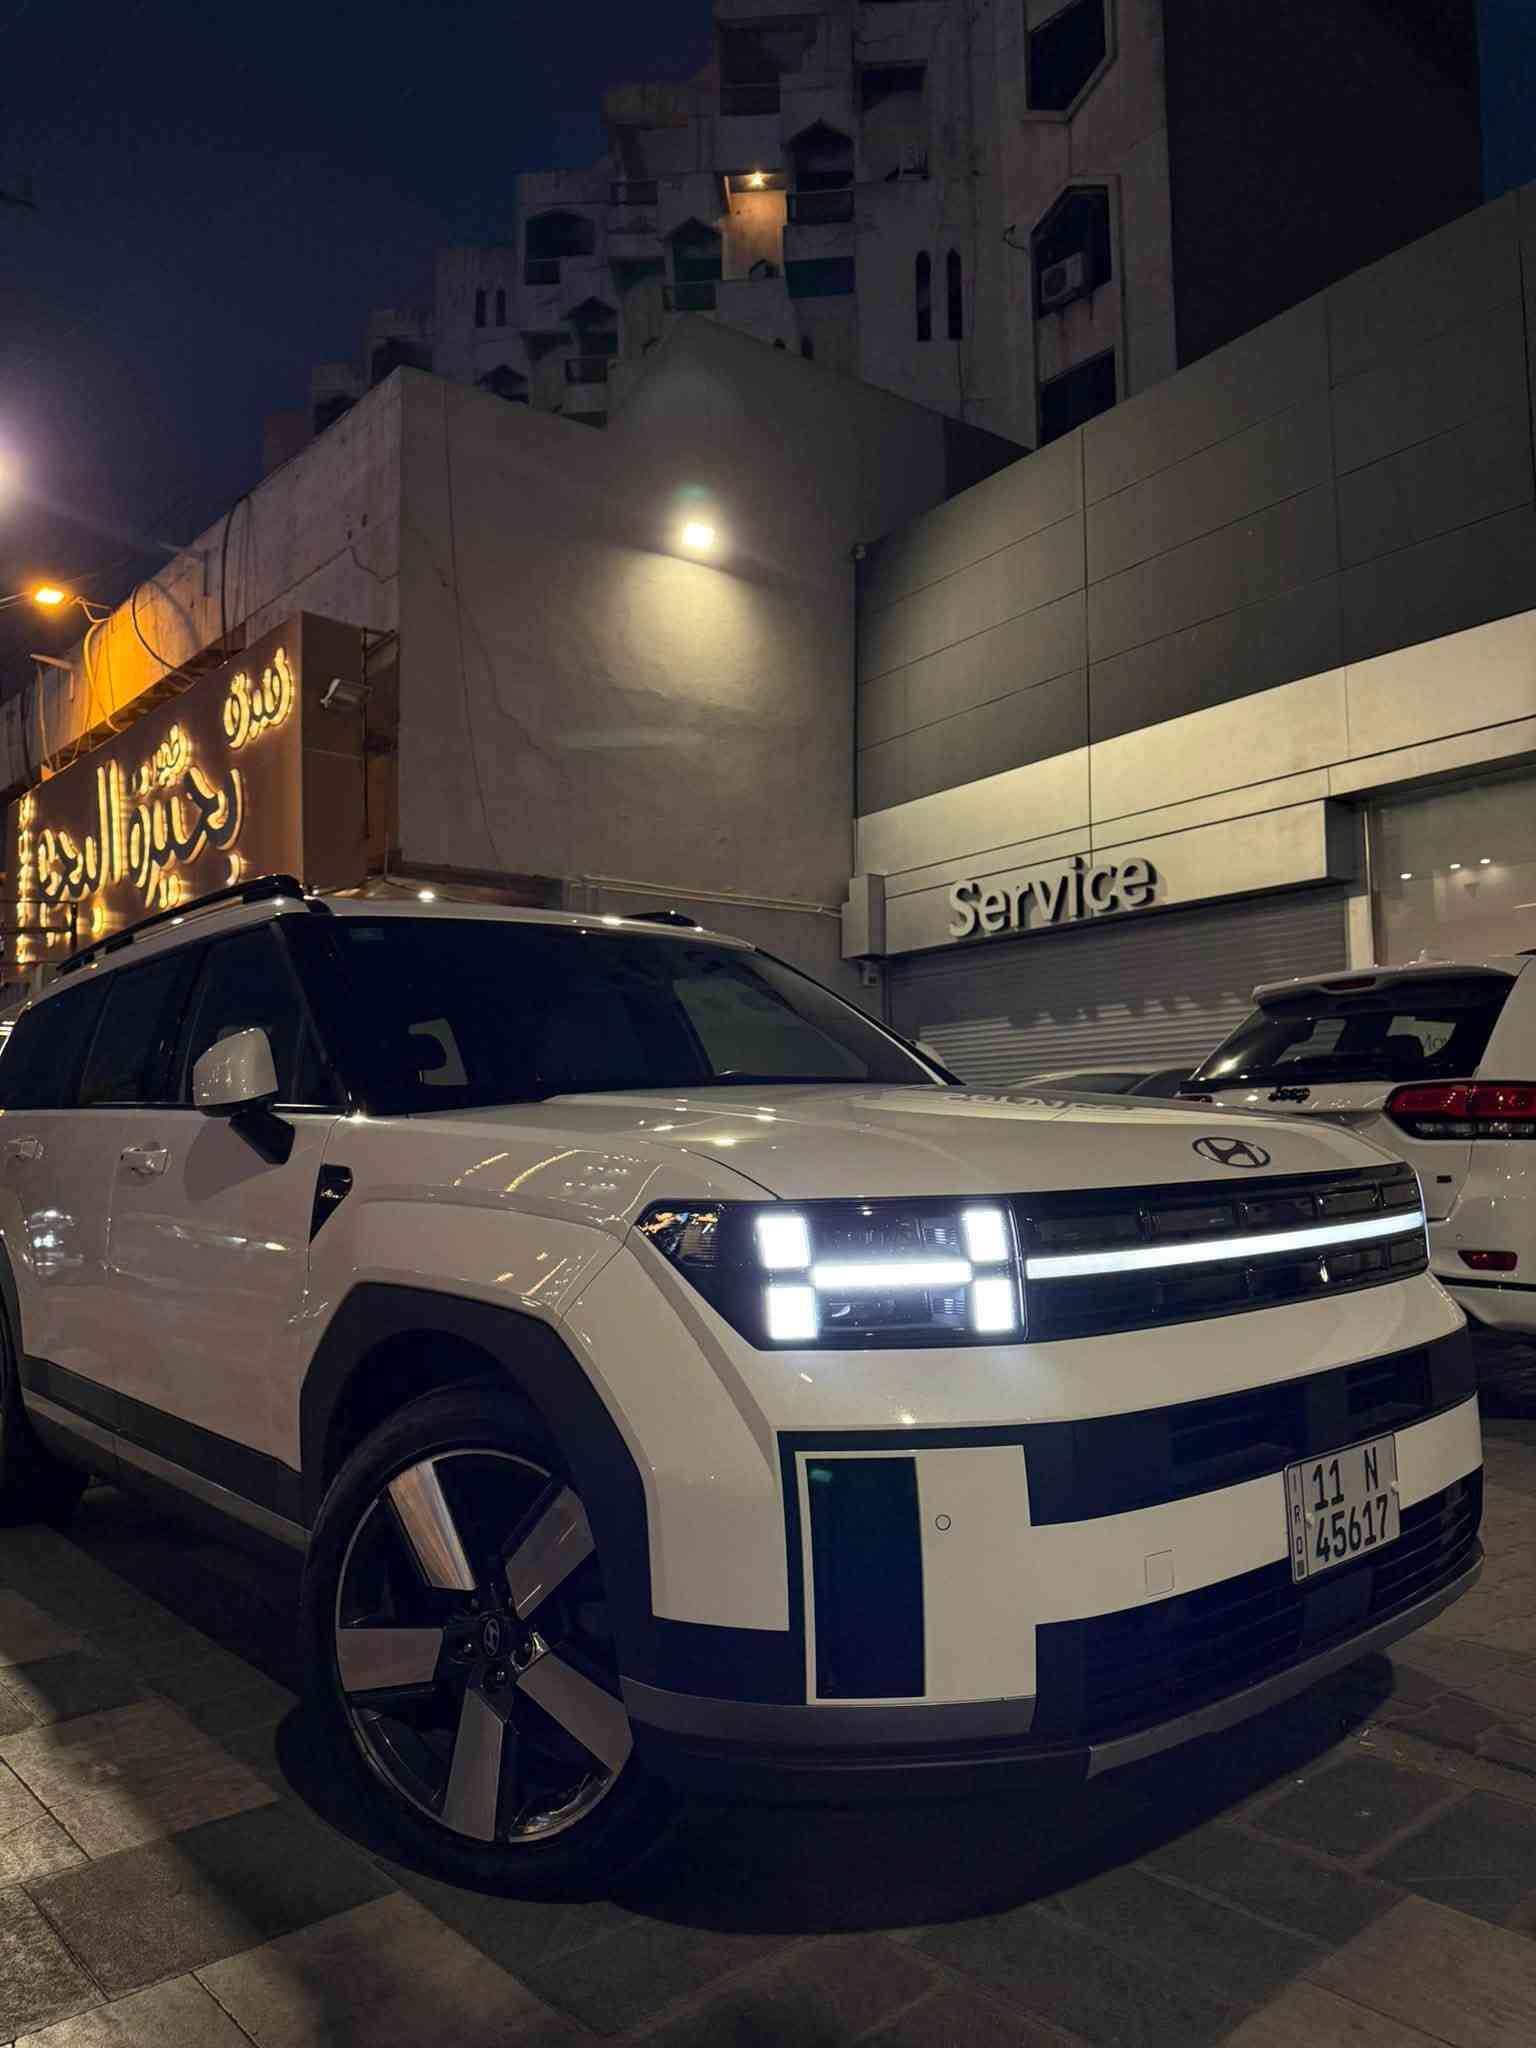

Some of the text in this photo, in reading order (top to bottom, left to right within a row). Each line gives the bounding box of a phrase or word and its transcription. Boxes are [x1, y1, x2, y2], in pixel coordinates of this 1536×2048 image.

[949, 856, 1158, 937] Service
[1313, 1447, 1379, 1511] 11 N
[1316, 1494, 1388, 1562] 45617
